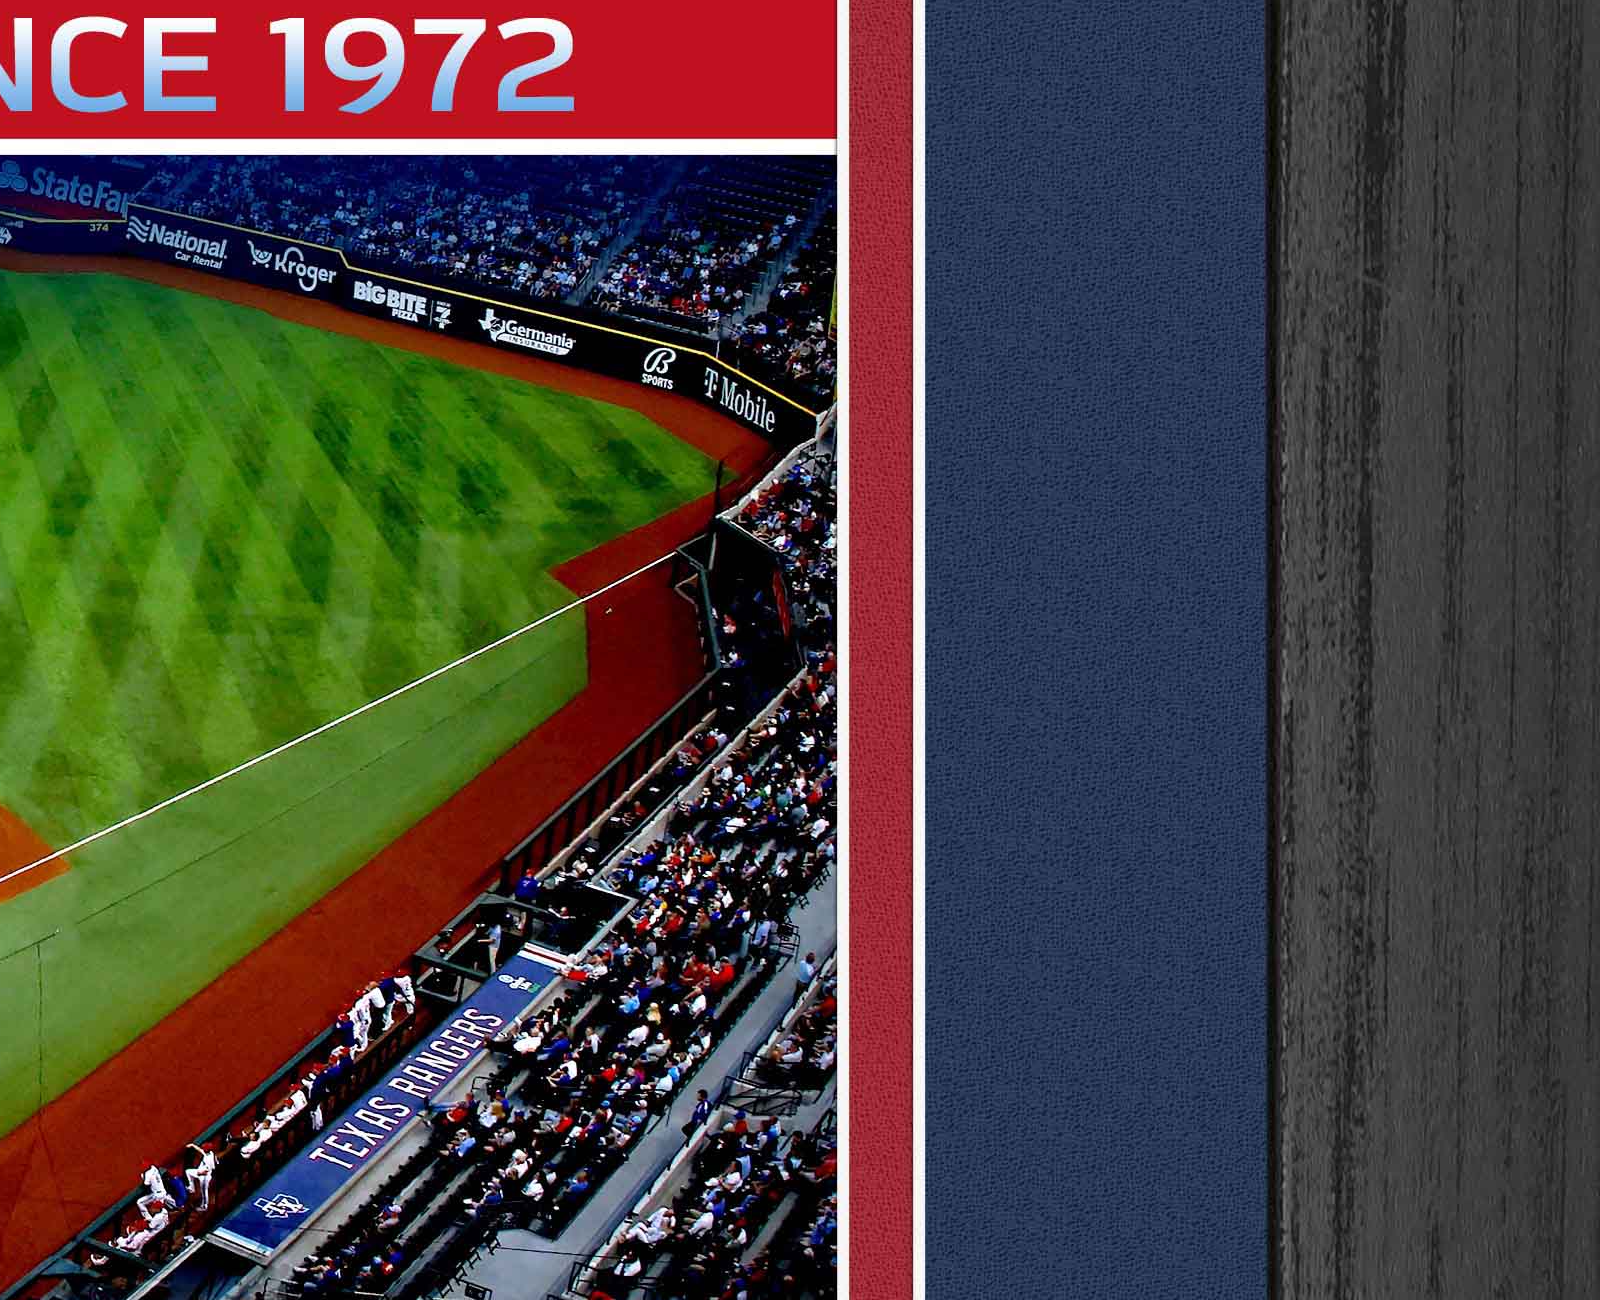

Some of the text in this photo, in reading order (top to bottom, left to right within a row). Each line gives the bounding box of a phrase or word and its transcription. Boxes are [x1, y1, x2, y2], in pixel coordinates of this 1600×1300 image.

[269, 16, 575, 115] 1972
[89, 223, 109, 232] 374
[175, 251, 222, 270] Car Rental
[274, 247, 337, 292] Kroger
[386, 288, 428, 316] BITE
[391, 308, 419, 323] PIZZA
[504, 318, 575, 351] Germania
[643, 347, 677, 374] B
[641, 373, 674, 390] SPORTS
[719, 376, 776, 433] Mobile
[309, 1007, 505, 1170] TEXAS RANGERS
